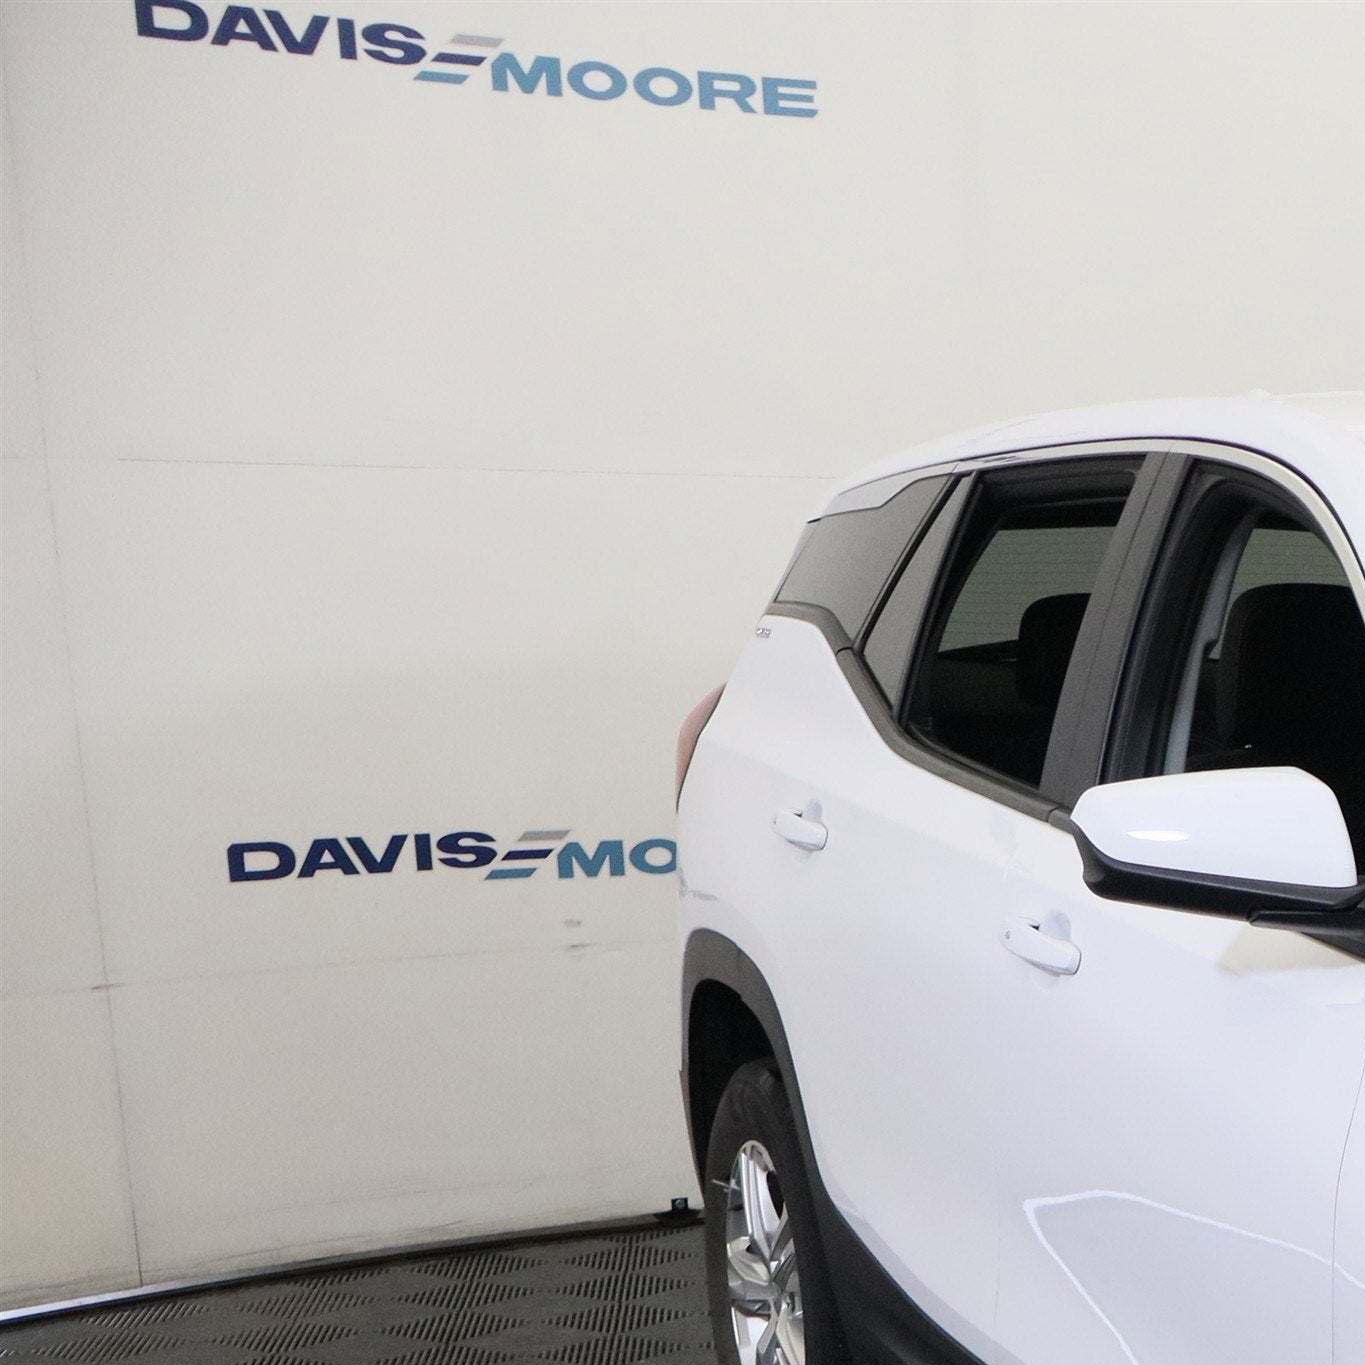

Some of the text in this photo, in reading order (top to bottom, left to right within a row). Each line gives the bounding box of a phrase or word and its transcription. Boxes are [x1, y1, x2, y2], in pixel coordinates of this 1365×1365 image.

[135, 0, 820, 119] DAVIS MOORE
[227, 831, 499, 882] DAVIS
